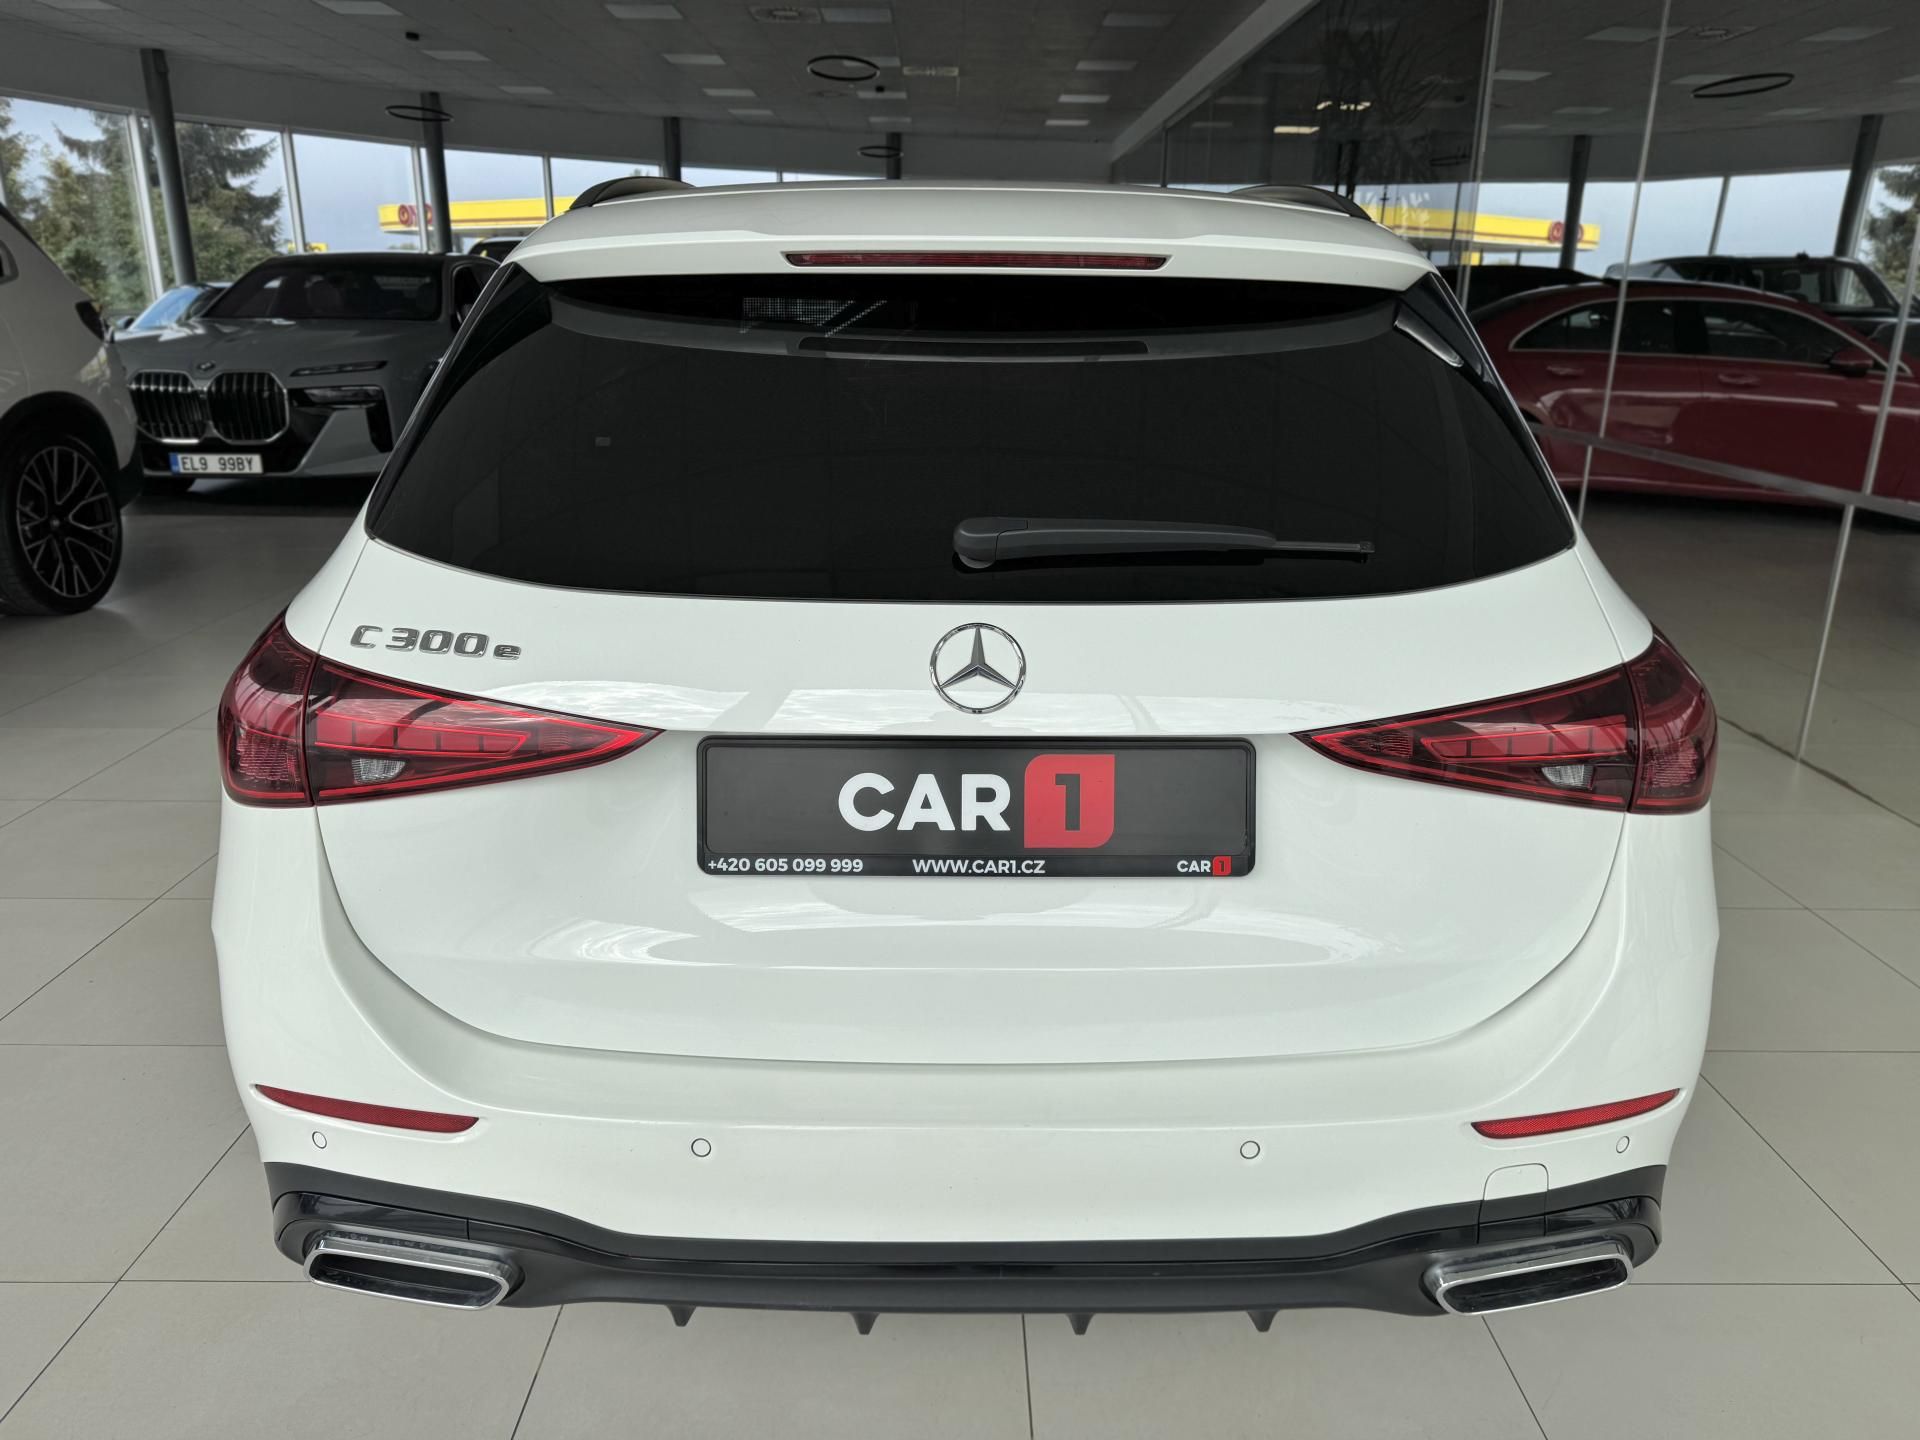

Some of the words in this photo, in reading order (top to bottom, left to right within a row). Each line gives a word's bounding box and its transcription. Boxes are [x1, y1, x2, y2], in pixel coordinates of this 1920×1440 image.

[181, 456, 208, 471] EL9
[218, 456, 253, 471] 99BY
[708, 858, 750, 872] +420
[754, 858, 788, 872] 605
[792, 858, 826, 872] 099
[830, 858, 863, 872] 999
[912, 859, 1046, 874] WWW.CAR1.CZ
